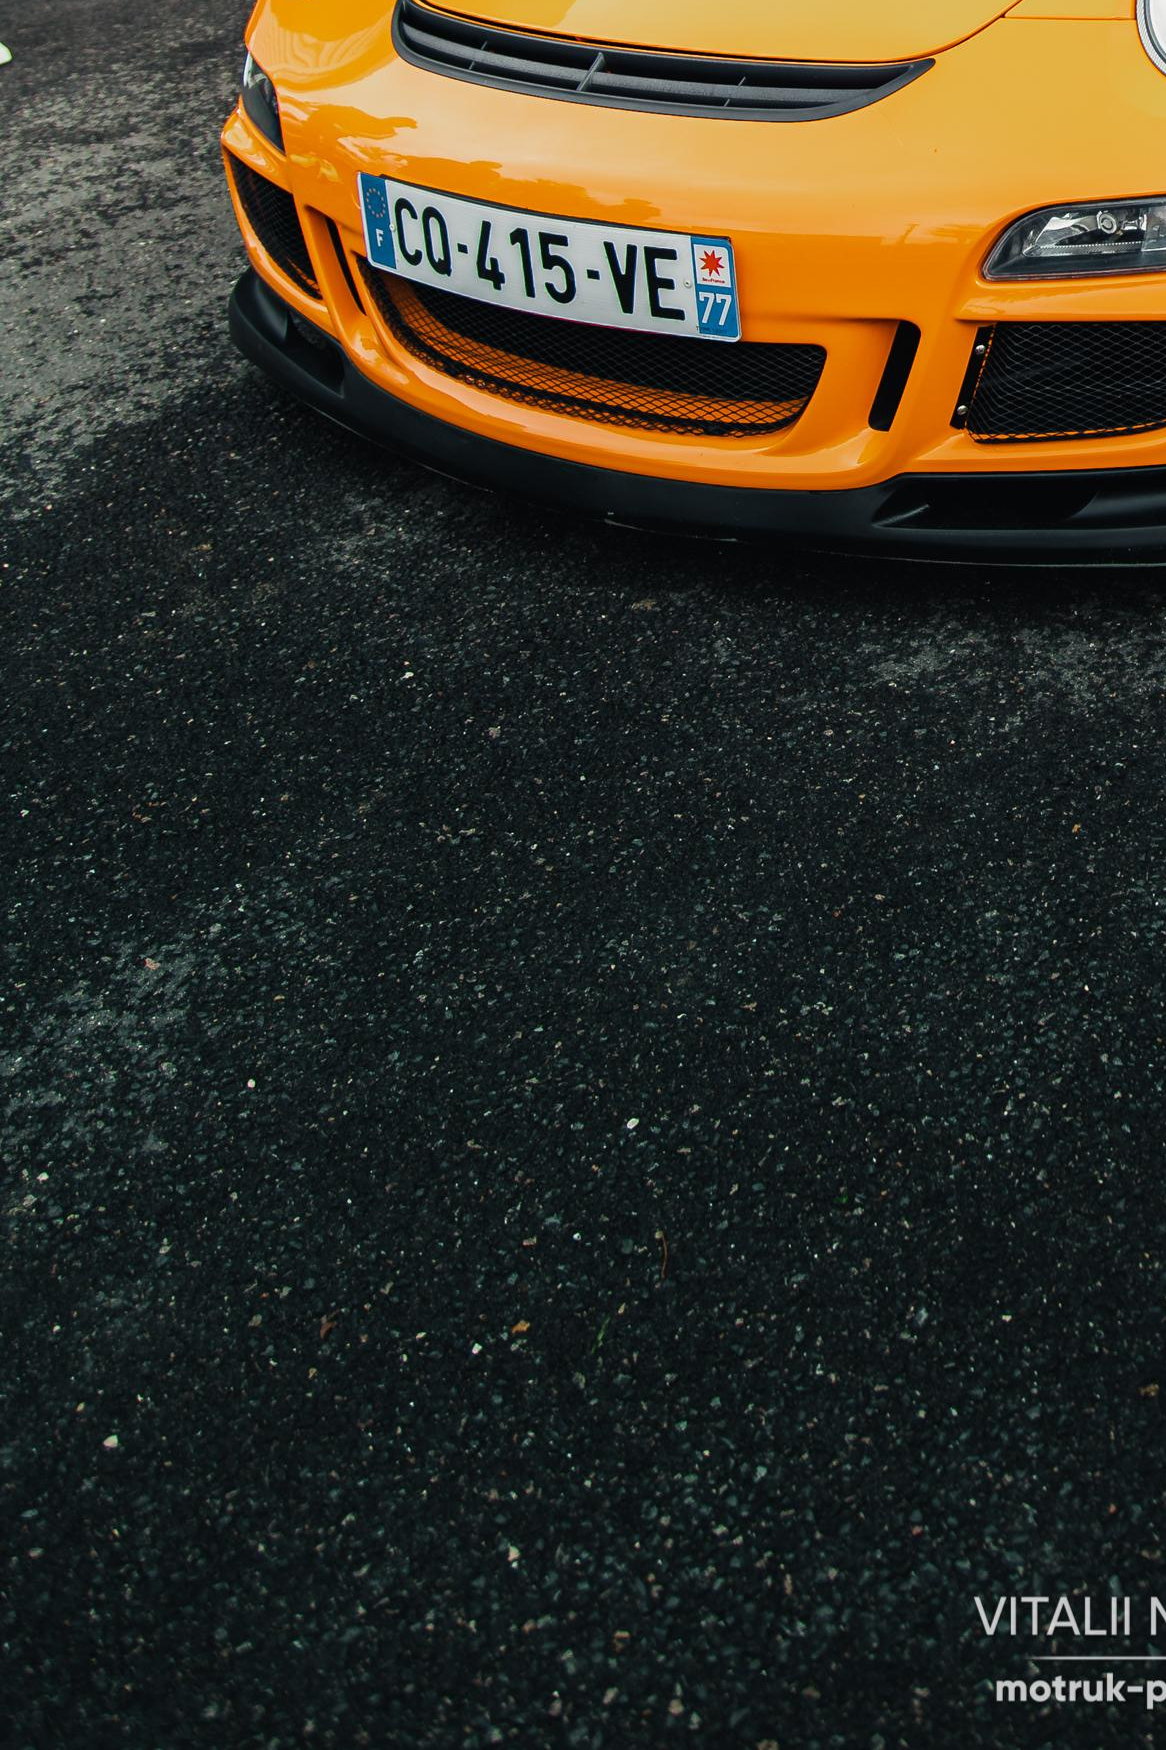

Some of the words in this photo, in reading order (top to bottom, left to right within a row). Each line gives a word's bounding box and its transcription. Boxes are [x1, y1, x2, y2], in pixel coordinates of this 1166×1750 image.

[375, 228, 385, 248] F
[394, 197, 686, 321] CQ-415-VE
[698, 291, 733, 326] 77
